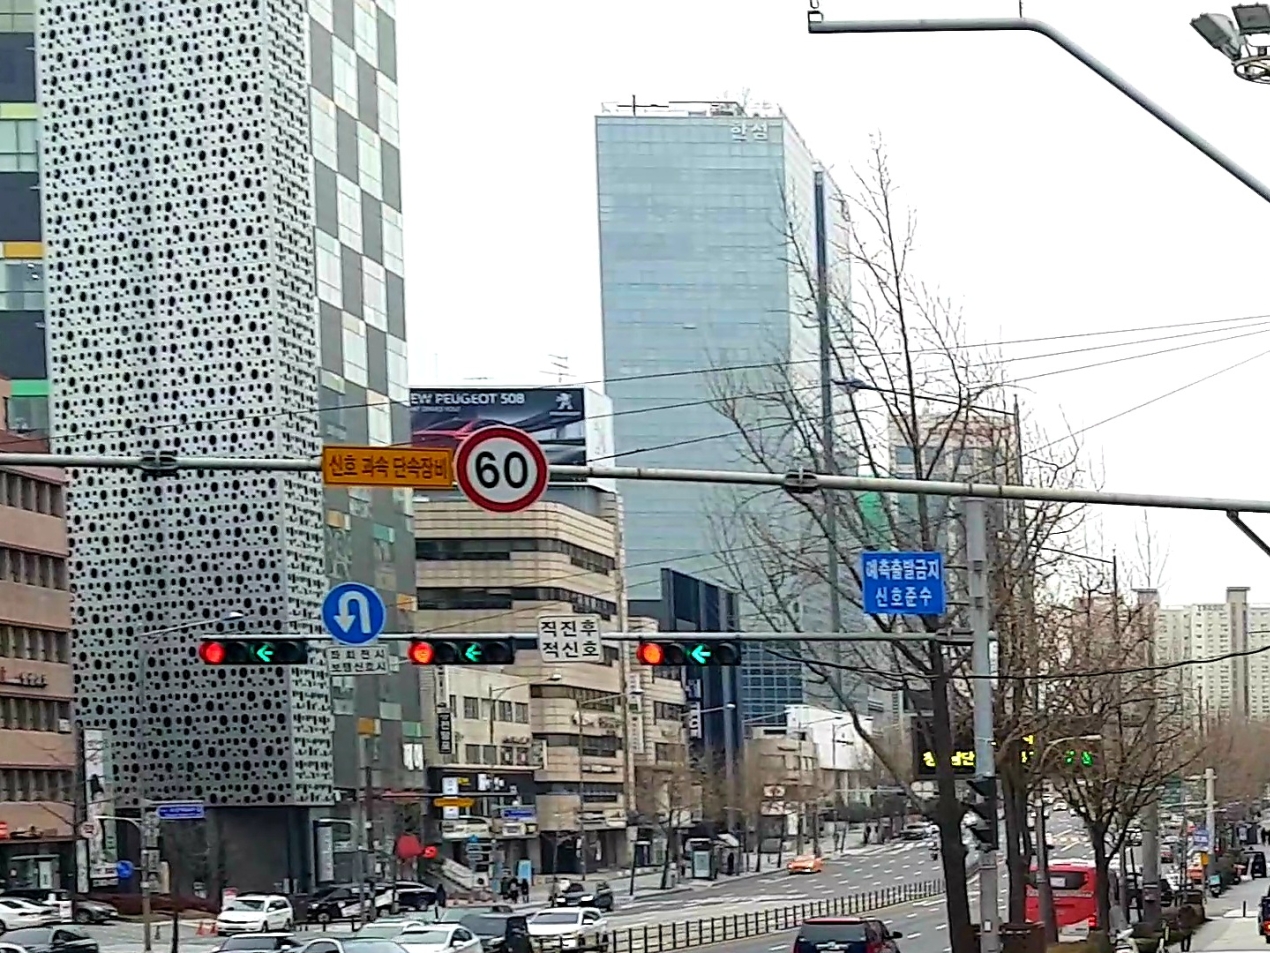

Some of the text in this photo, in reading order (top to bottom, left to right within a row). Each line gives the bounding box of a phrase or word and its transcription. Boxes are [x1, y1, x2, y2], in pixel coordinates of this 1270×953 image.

[410, 393, 525, 404] EW PEUGEOT 508
[329, 454, 447, 480] 신호 과속 단속장비
[475, 451, 528, 489] 60
[865, 558, 940, 580] 예측출발금지
[875, 586, 933, 608] 신호준수
[540, 619, 598, 637] 직진후
[541, 641, 599, 658] 적신호
